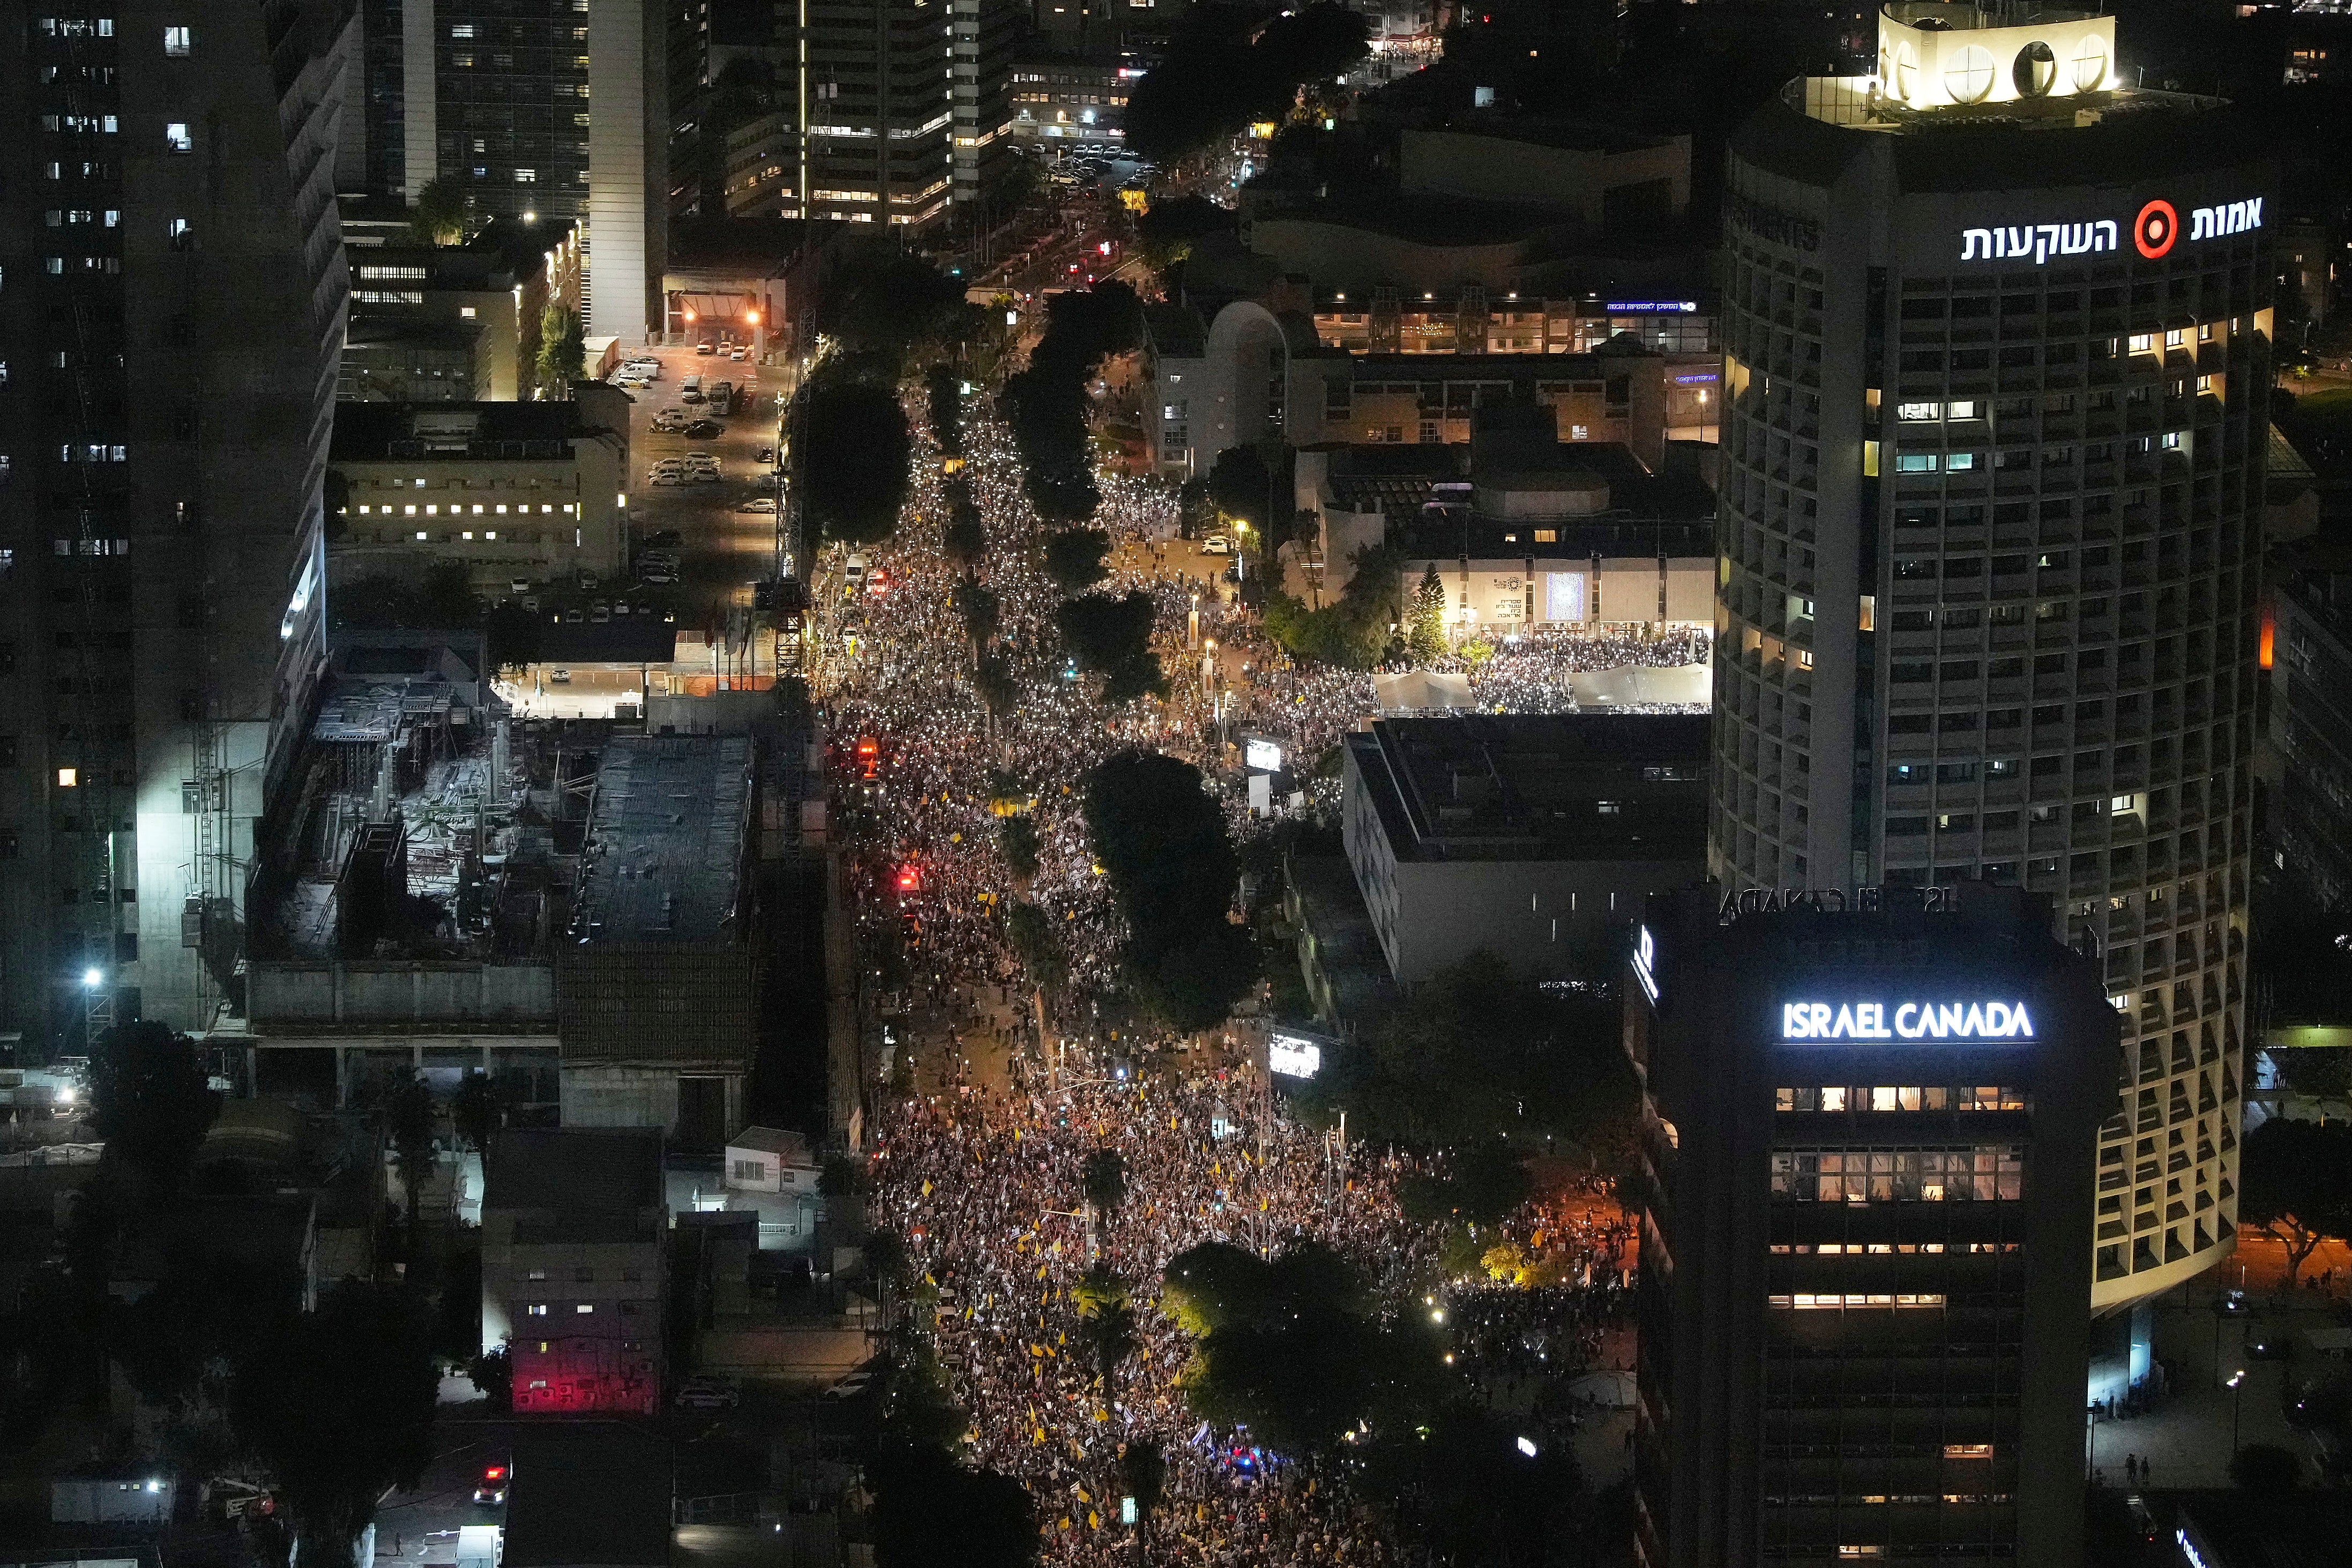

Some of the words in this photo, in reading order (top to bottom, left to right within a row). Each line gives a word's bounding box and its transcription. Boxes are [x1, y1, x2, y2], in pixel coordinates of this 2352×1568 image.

[2191, 197, 2261, 240] אמות
[1961, 220, 2117, 264] השקעות
[1783, 1003, 1891, 1038] ISRAEL
[1895, 1002, 2033, 1038] CANADA
